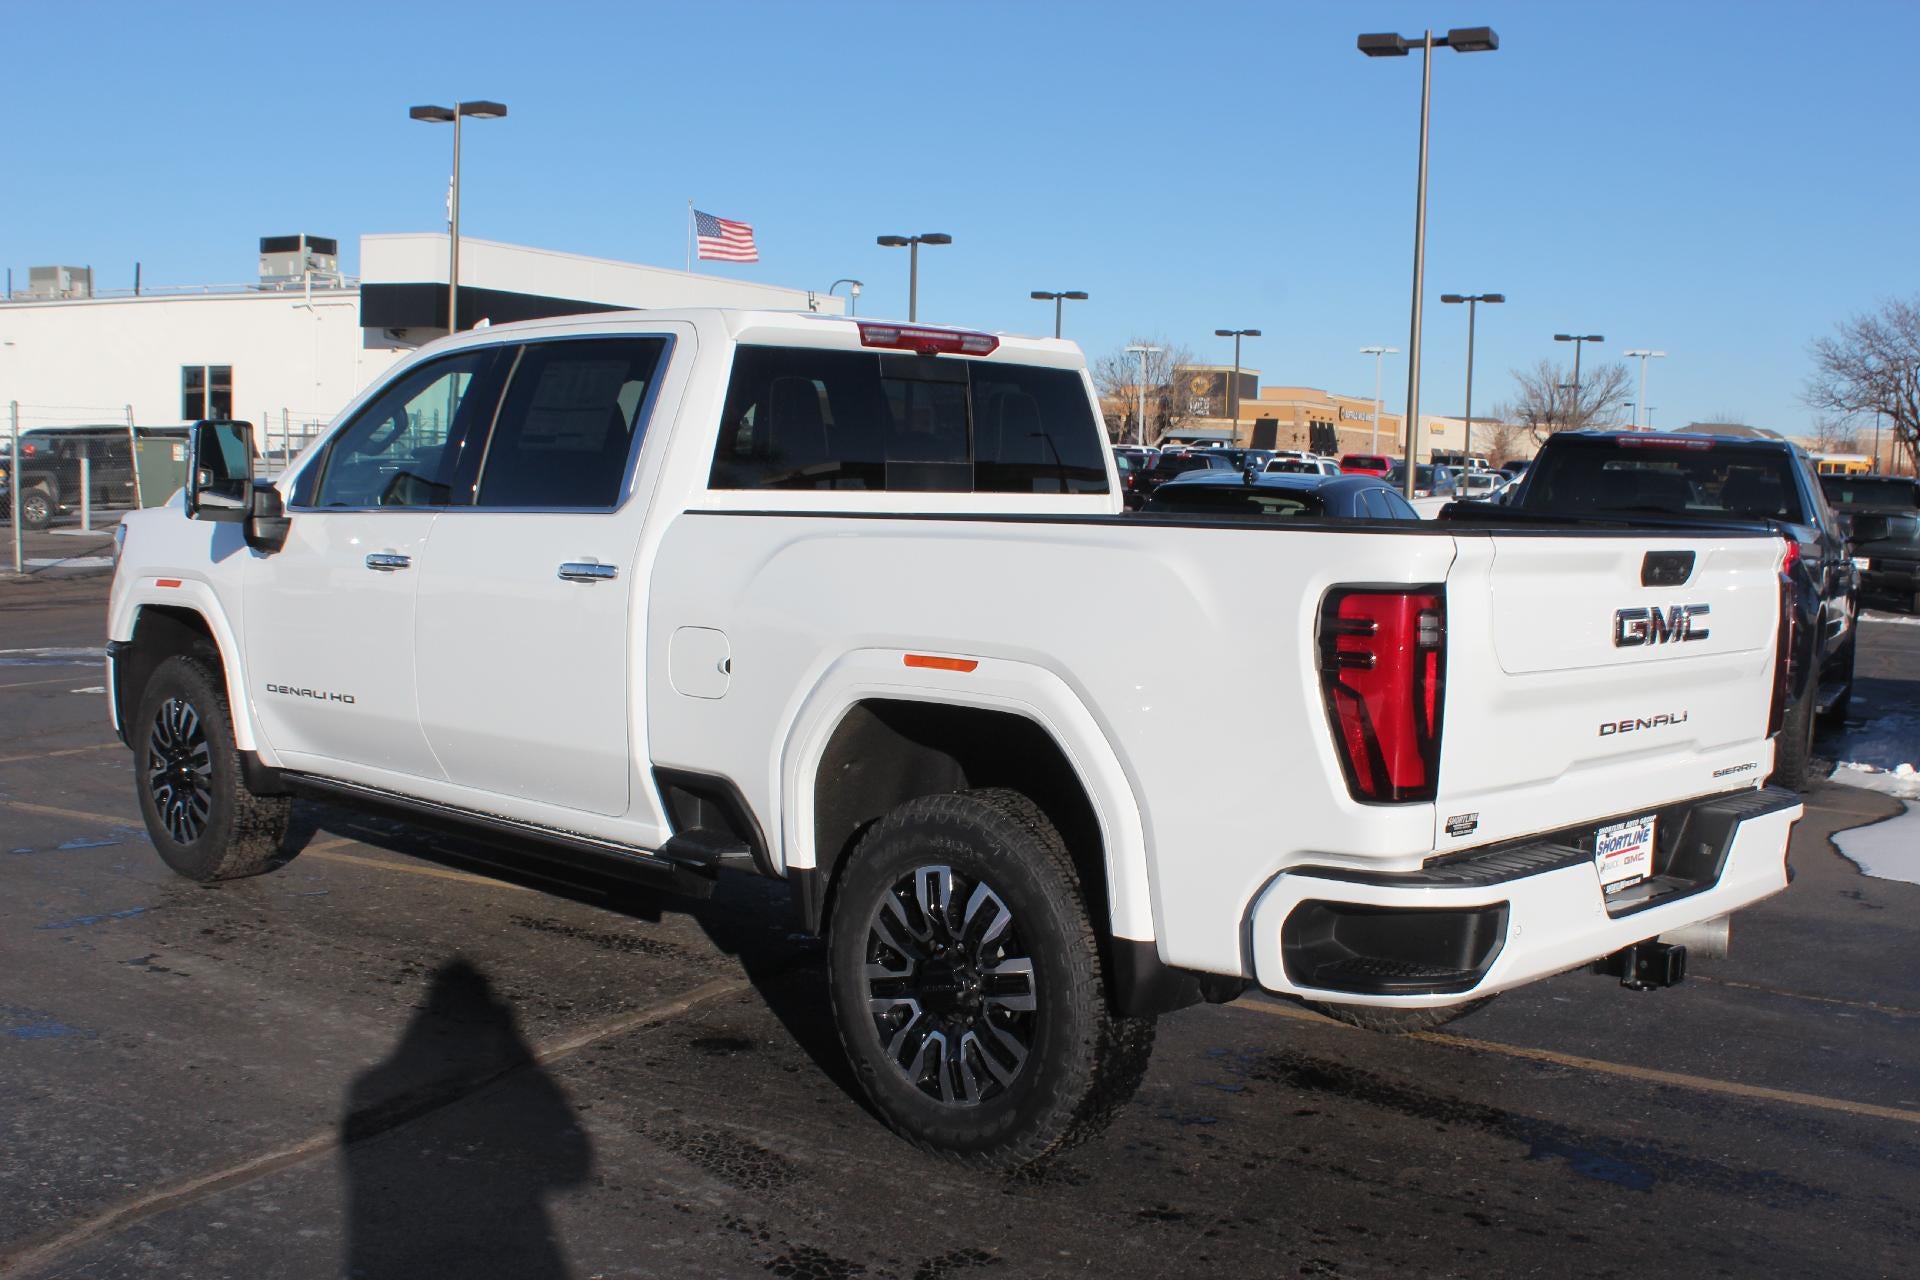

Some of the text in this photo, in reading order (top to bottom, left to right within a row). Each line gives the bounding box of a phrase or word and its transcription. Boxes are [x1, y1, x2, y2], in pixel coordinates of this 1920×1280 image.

[1614, 603, 1711, 648] GMC
[266, 683, 355, 704] DENALI HD
[1599, 710, 1688, 737] DENALI
[1712, 762, 1758, 778] SIERRA
[1597, 828, 1650, 856] SHORTLINE
[1623, 852, 1645, 865] GMC
